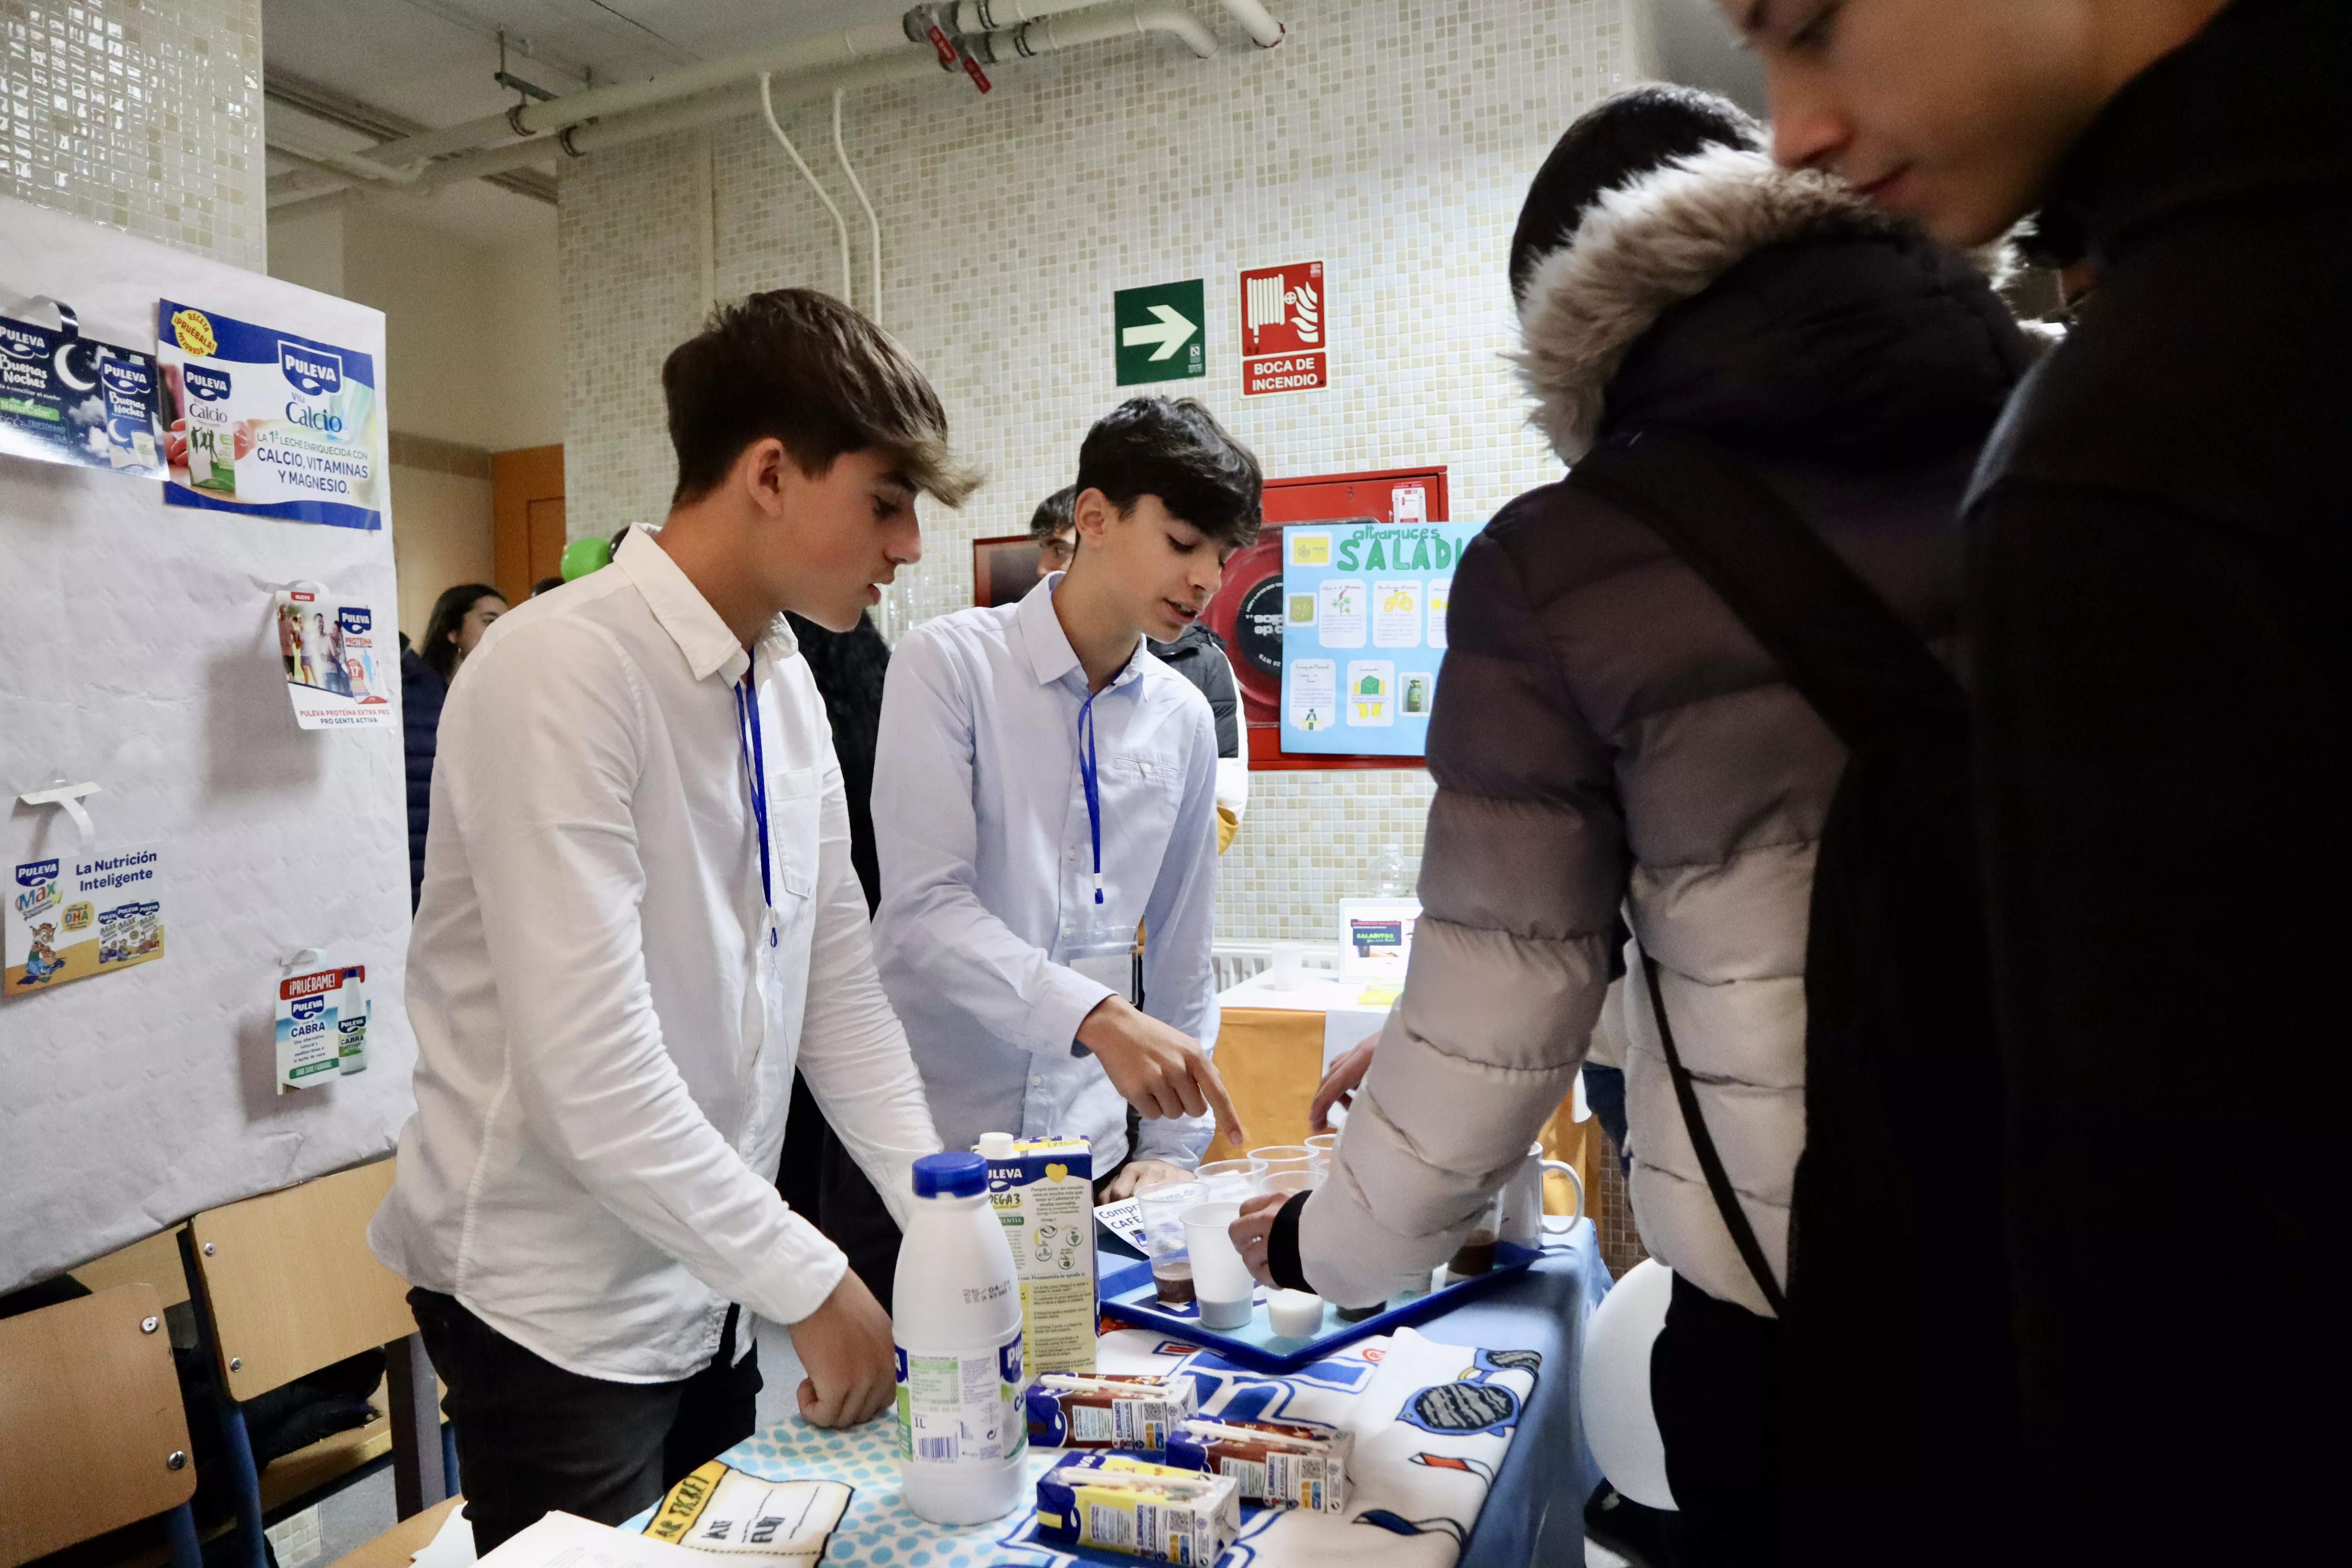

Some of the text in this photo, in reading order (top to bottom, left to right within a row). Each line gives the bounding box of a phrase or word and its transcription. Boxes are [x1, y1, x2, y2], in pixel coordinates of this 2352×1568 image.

[187, 313, 209, 332] RECETA
[0, 325, 45, 348] PULEVA
[178, 332, 204, 356] MEJORADA
[0, 354, 47, 379] Buenas
[104, 363, 147, 383] PULEVA
[285, 355, 336, 381] PULEVA
[1254, 358, 1315, 375] BOCA DE
[4, 370, 46, 388] Noches
[187, 371, 227, 391] PULEVA
[1252, 373, 1318, 391] INCENDIO
[109, 391, 145, 410] Buenas
[291, 392, 305, 404] Vita
[114, 404, 144, 417] Noches
[190, 404, 228, 423] Calcio
[286, 402, 342, 432] Calcio
[257, 432, 267, 443] LA
[280, 437, 303, 449] LECHE
[304, 442, 352, 457] ENRIQUECIDA
[353, 450, 367, 460] CON
[257, 448, 368, 479] CALCIO, VITAMINAS
[278, 470, 350, 494] Y MAGNESIO.
[1353, 524, 1441, 541] altramuces
[1337, 537, 1462, 572] SALADI
[342, 613, 370, 624] PULEVA
[18, 864, 58, 878] PULEVA
[76, 851, 157, 875] La Nutrición
[80, 869, 152, 891] Inteligente
[19, 881, 56, 911] Max
[65, 910, 88, 923] DHA
[118, 906, 138, 915] PULEVA
[290, 973, 335, 996] ¡PRUÉBAME!
[293, 1000, 323, 1013] PULEVA
[291, 1022, 325, 1037] CABRA
[341, 1019, 363, 1028] PULEVA
[341, 1035, 364, 1045] CABRA
[915, 1417, 926, 1428] 1L
